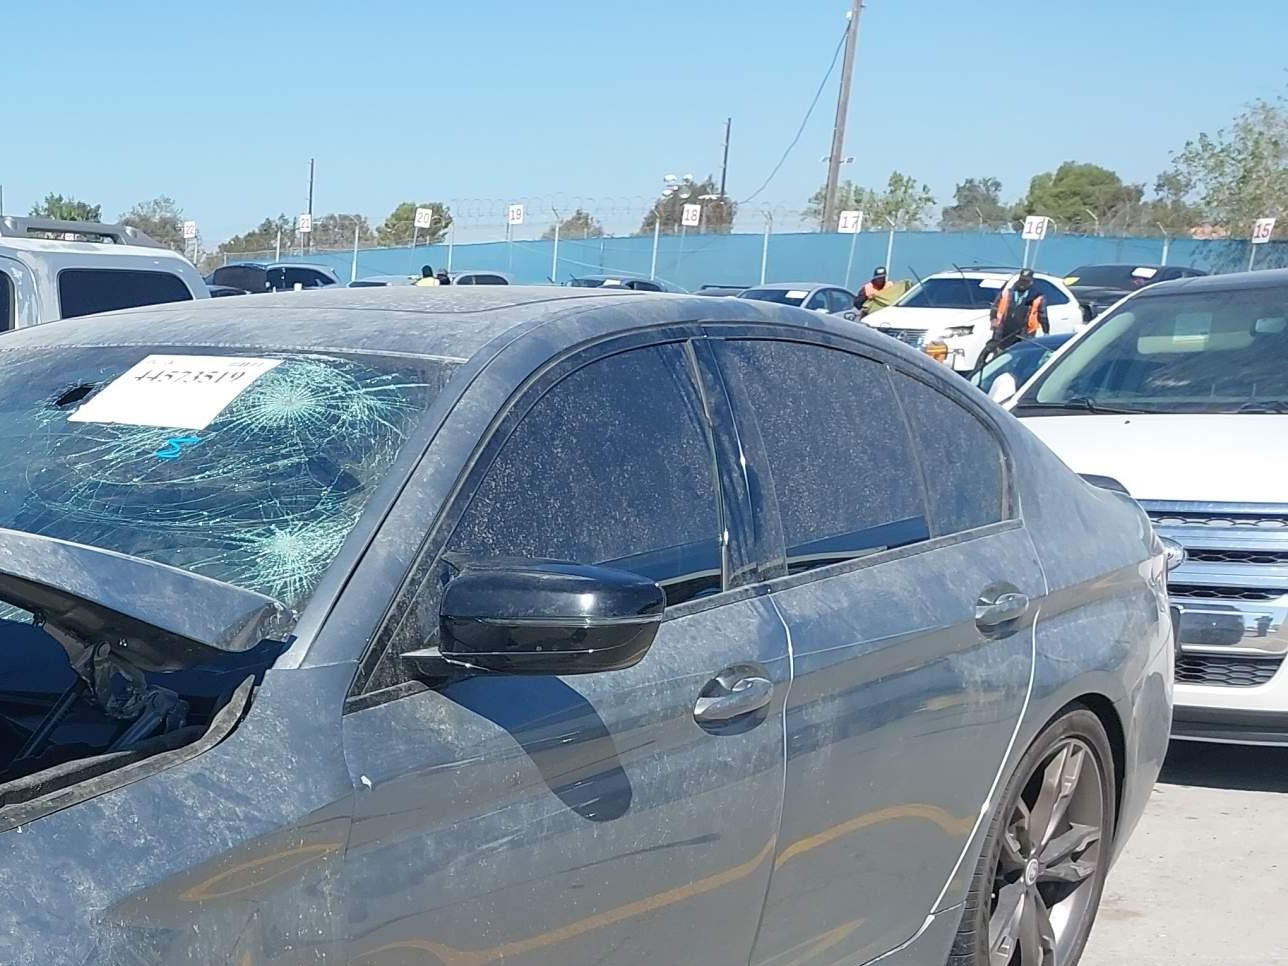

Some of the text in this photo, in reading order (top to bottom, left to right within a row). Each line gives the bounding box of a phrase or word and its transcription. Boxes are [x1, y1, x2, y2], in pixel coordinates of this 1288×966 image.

[416, 212, 430, 224] 20
[511, 208, 522, 221] 19
[684, 209, 698, 222] 18
[840, 215, 860, 229] 17
[1025, 221, 1043, 235] 16
[1254, 223, 1270, 239] 15
